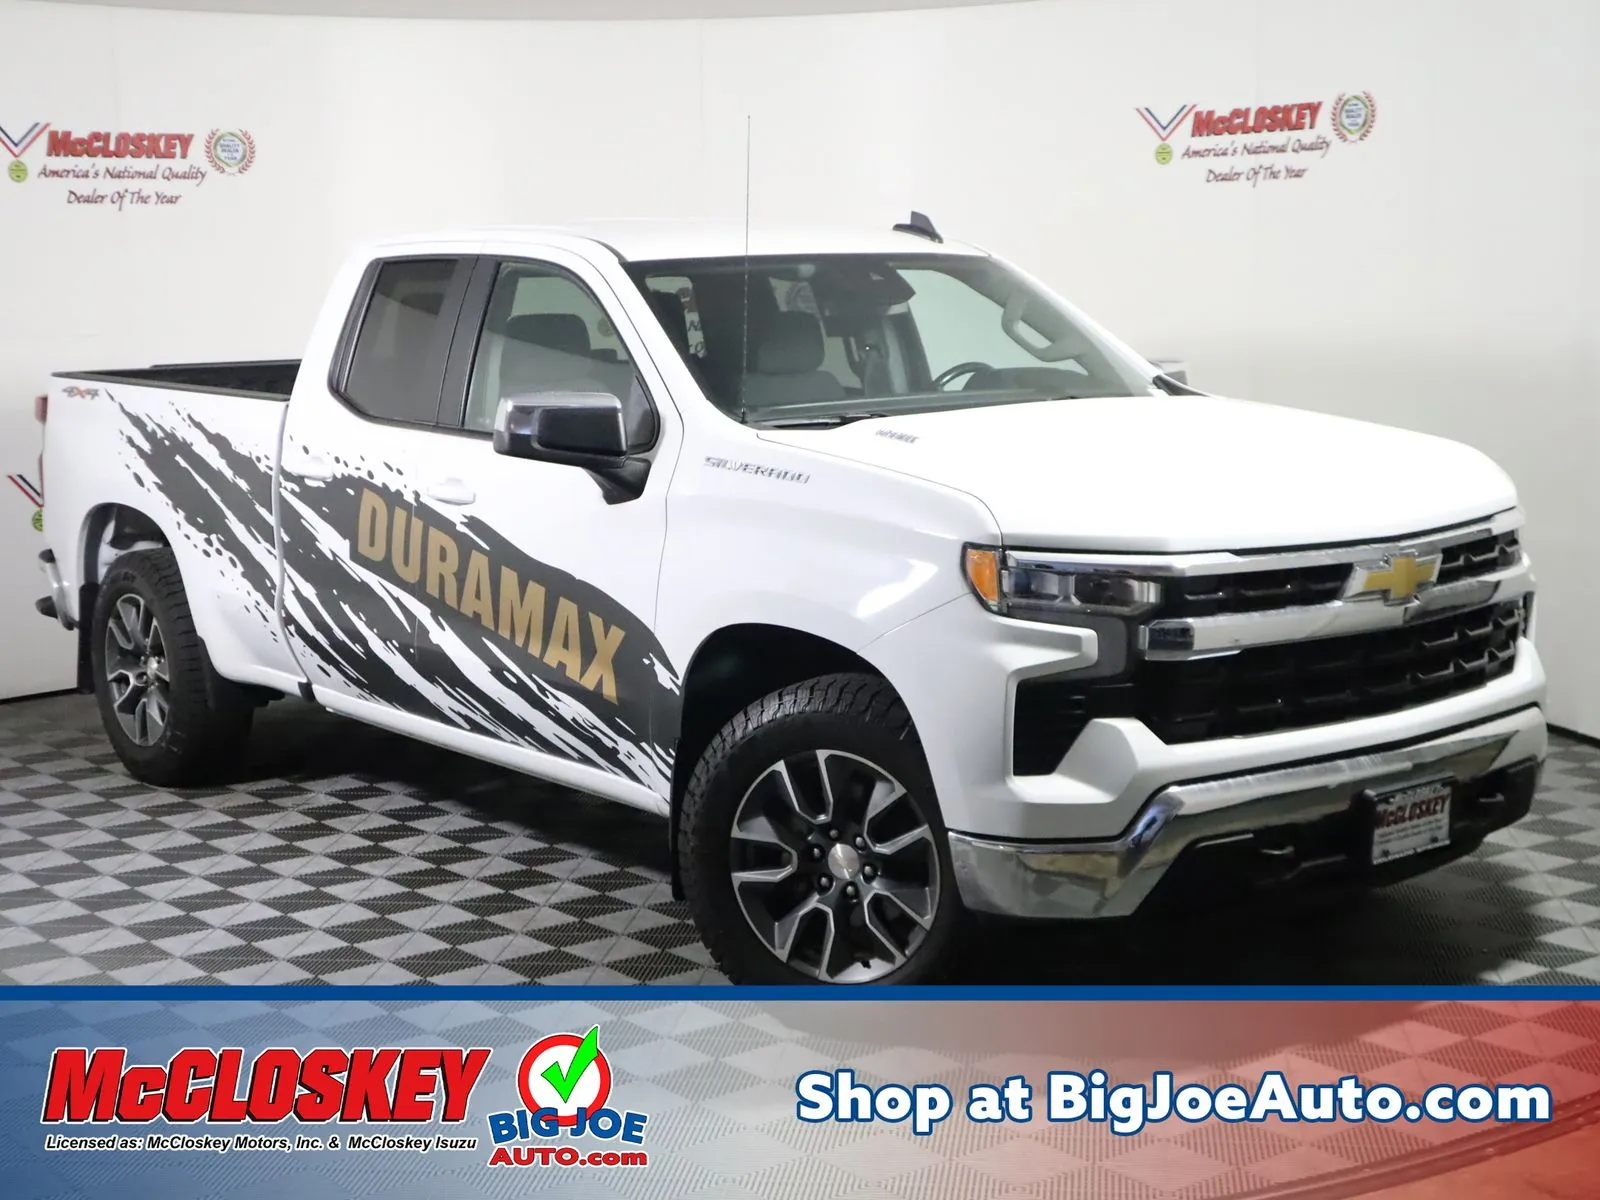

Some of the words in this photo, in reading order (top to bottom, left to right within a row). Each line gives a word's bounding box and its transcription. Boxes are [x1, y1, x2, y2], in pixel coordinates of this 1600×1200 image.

[1191, 101, 1324, 137] McCLOSKEY
[46, 130, 194, 159] McCLOSKEY
[1181, 141, 1238, 160] America's
[1241, 137, 1290, 157] National
[1291, 134, 1332, 159] Quality
[37, 162, 100, 180] America's
[103, 164, 158, 180] National
[162, 164, 207, 187] Quality
[1205, 166, 1243, 183] Dealer
[1246, 164, 1264, 188] Of
[1263, 164, 1282, 180] The
[1284, 165, 1308, 179] Year
[66, 188, 108, 205] Dealer
[110, 188, 129, 211] Of
[129, 190, 151, 205] The
[154, 191, 182, 205] Year
[703, 456, 811, 484] SILVERADO
[357, 487, 626, 706] DURAMAX
